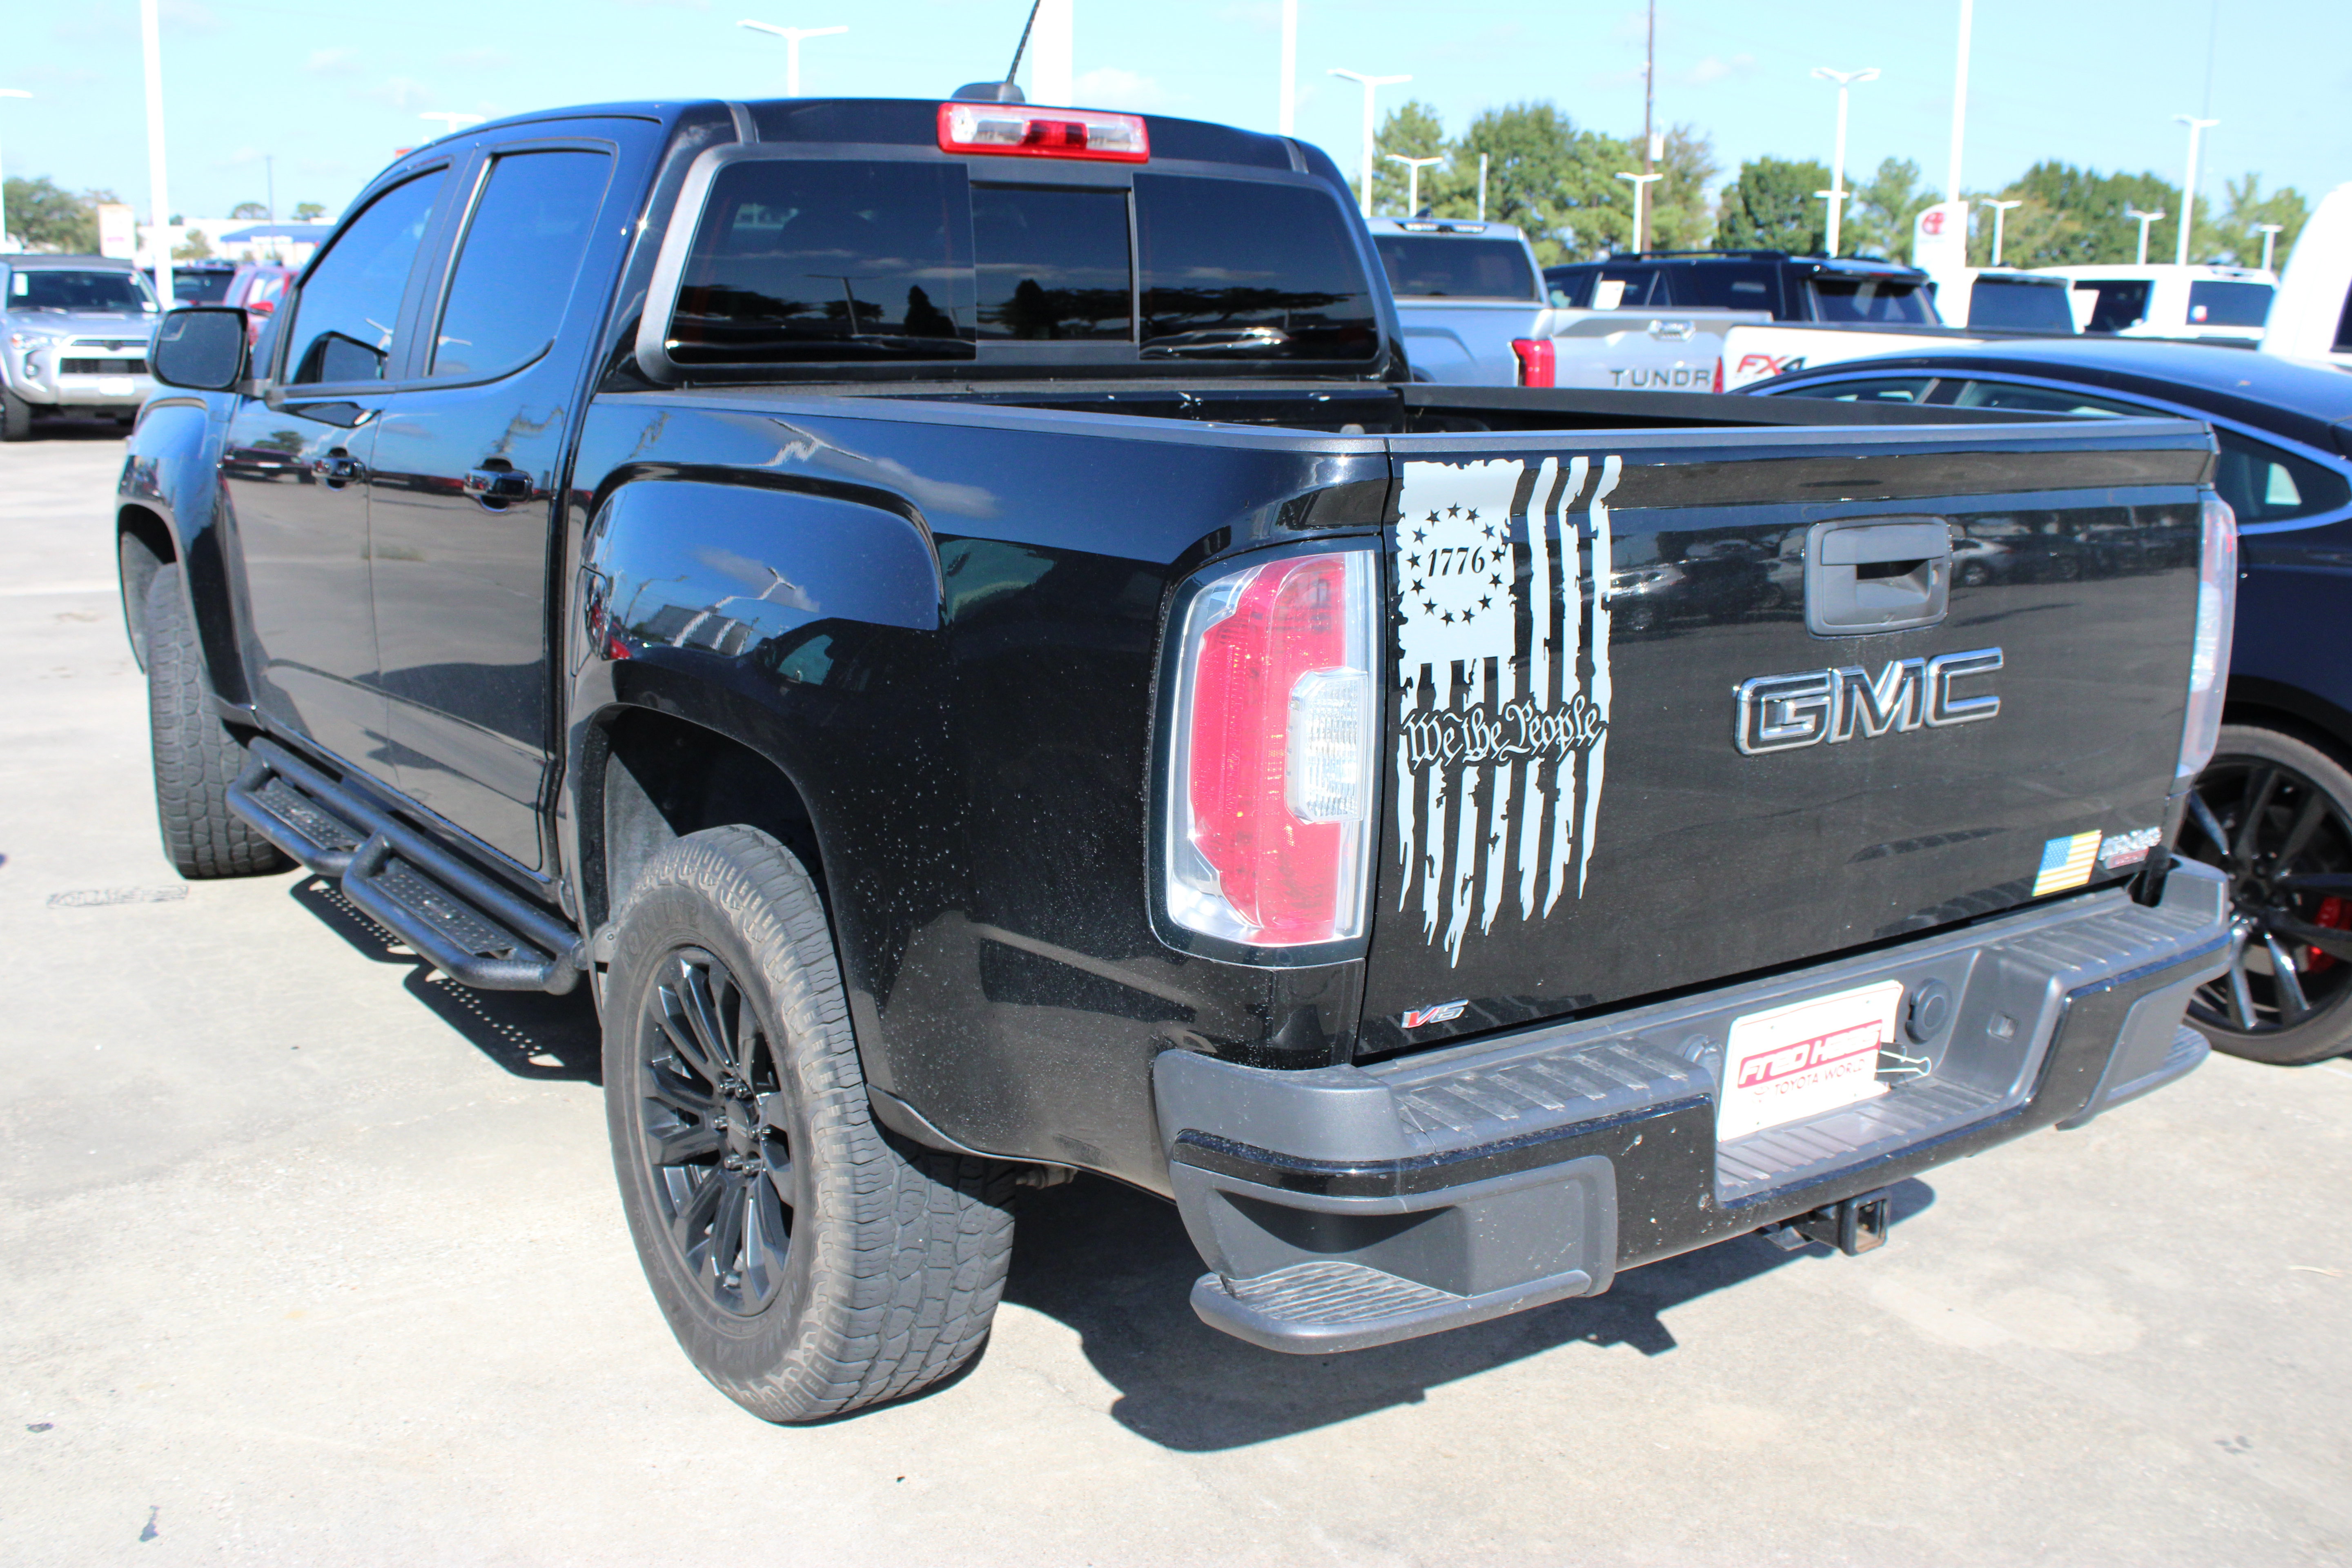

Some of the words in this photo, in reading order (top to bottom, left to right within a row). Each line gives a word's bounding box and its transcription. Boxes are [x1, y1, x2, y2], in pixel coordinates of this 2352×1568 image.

[1610, 368, 1712, 387] TUNDR
[1428, 546, 1485, 577] 1776
[1735, 647, 2004, 756] GMC
[1403, 712, 1463, 770] We
[1461, 708, 1510, 763] the
[1499, 695, 1601, 762] People
[1401, 999, 1469, 1029] V6
[1775, 1074, 1819, 1096] TOYOTA
[1825, 1058, 1865, 1081] WORLD
